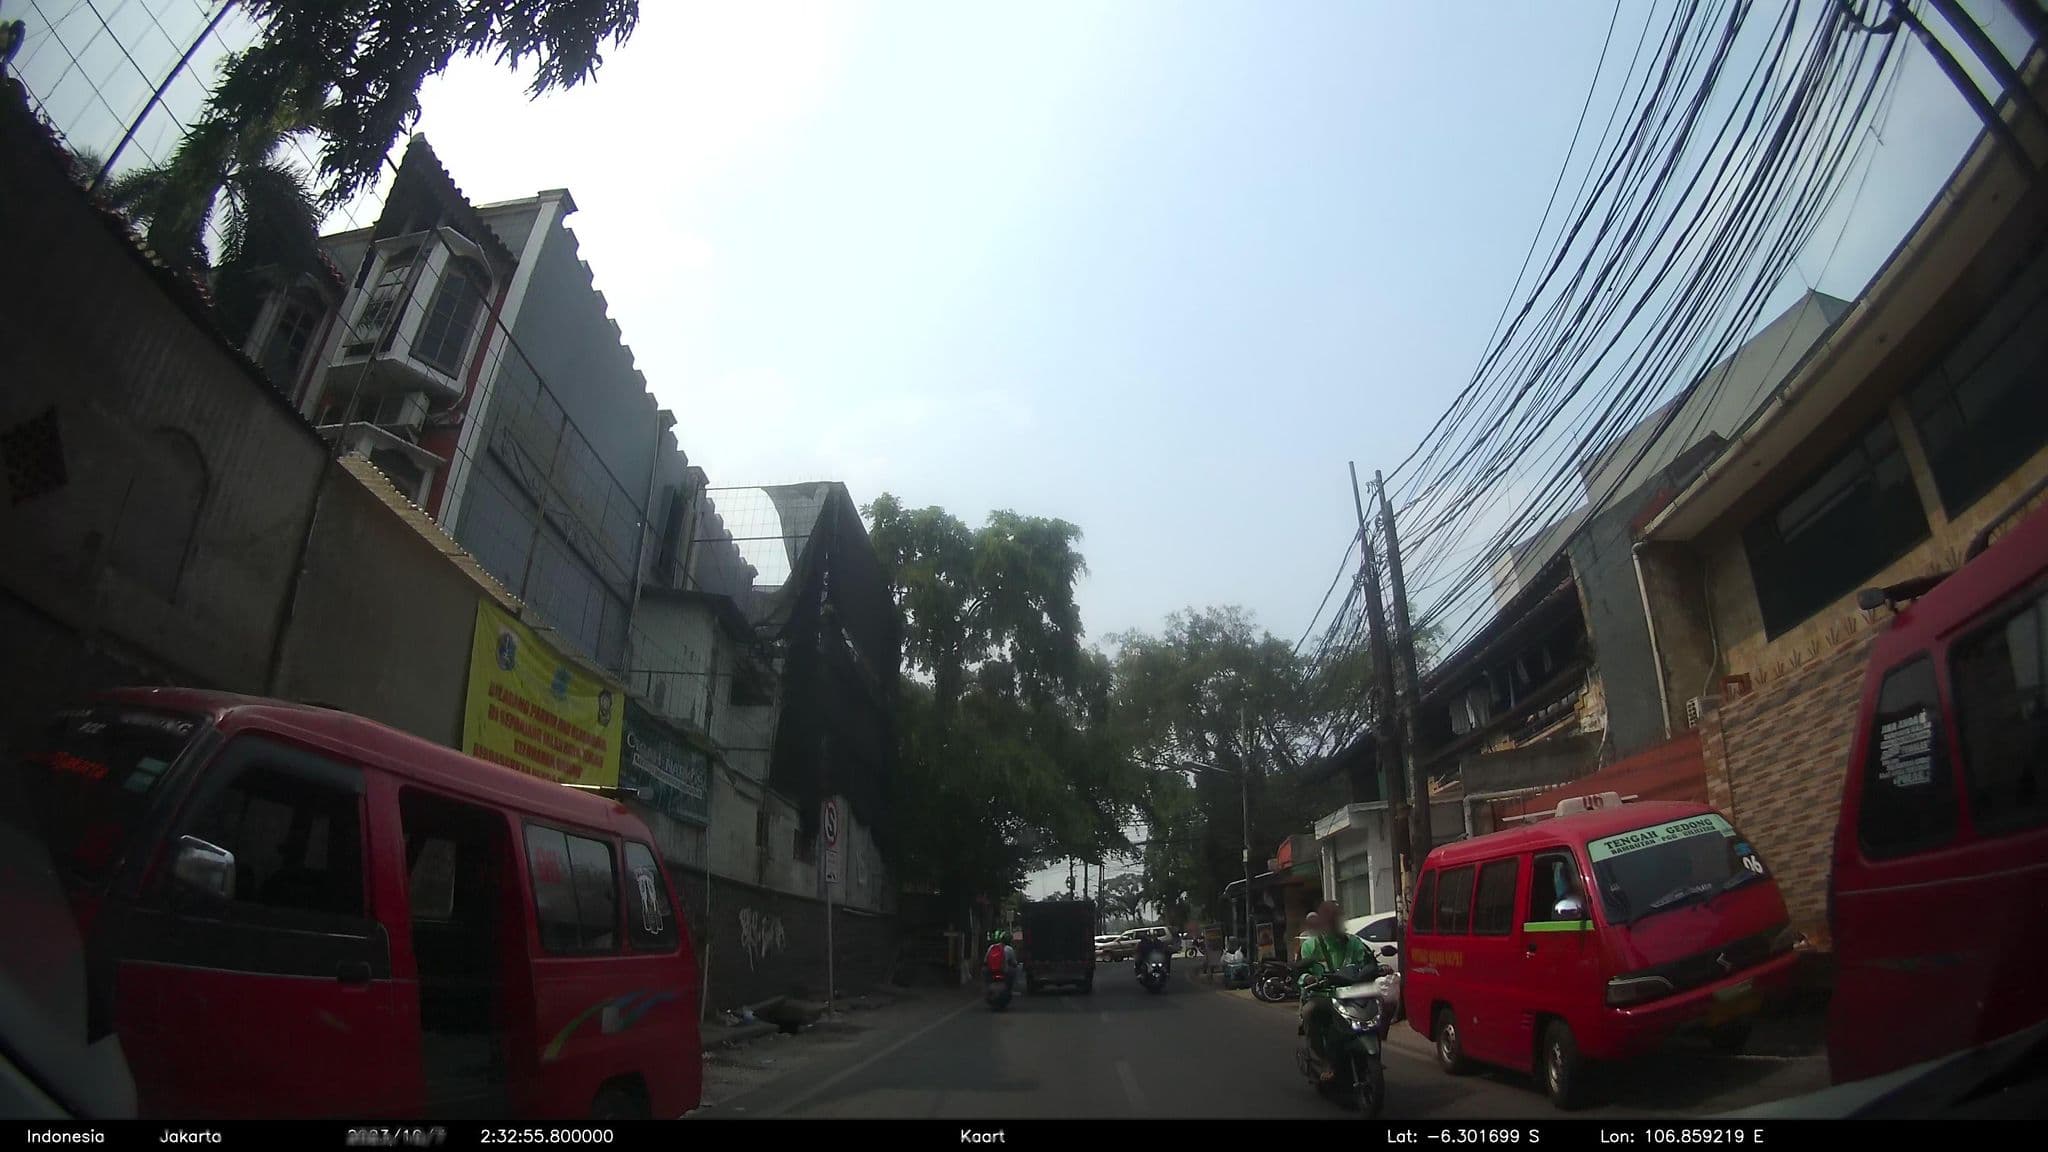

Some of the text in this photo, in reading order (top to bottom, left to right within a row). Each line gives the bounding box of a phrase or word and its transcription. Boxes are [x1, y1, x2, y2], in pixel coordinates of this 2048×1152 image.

[1604, 819, 1713, 849] TENGAH GEDONG
[1743, 855, 1763, 874] 06
